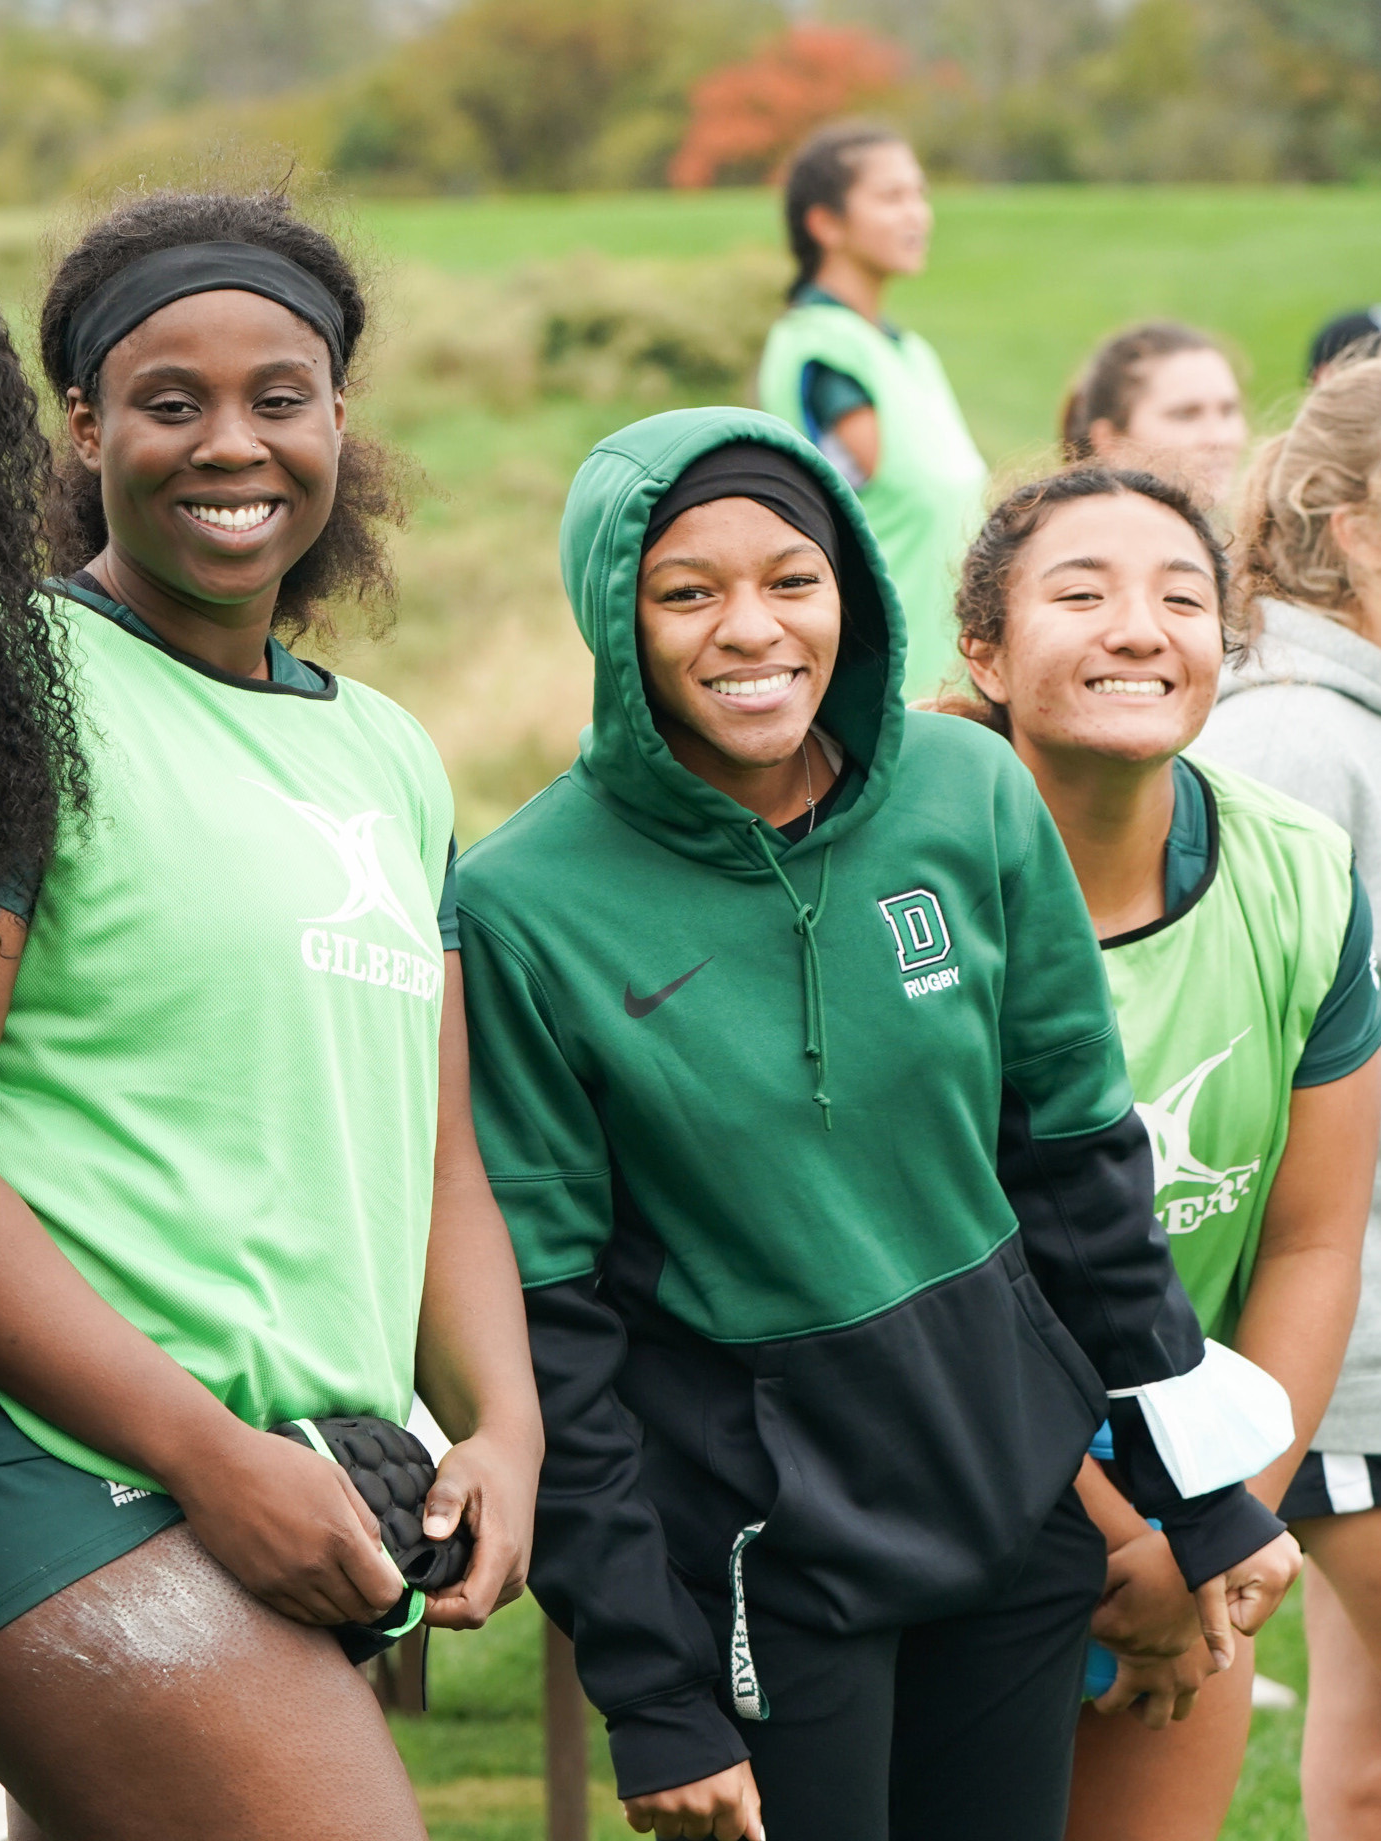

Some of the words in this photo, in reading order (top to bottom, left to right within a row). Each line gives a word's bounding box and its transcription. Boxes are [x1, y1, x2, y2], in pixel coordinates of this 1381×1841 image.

[878, 889, 951, 973] D
[903, 966, 960, 999] RUGBY
[112, 1488, 152, 1508] RHI
